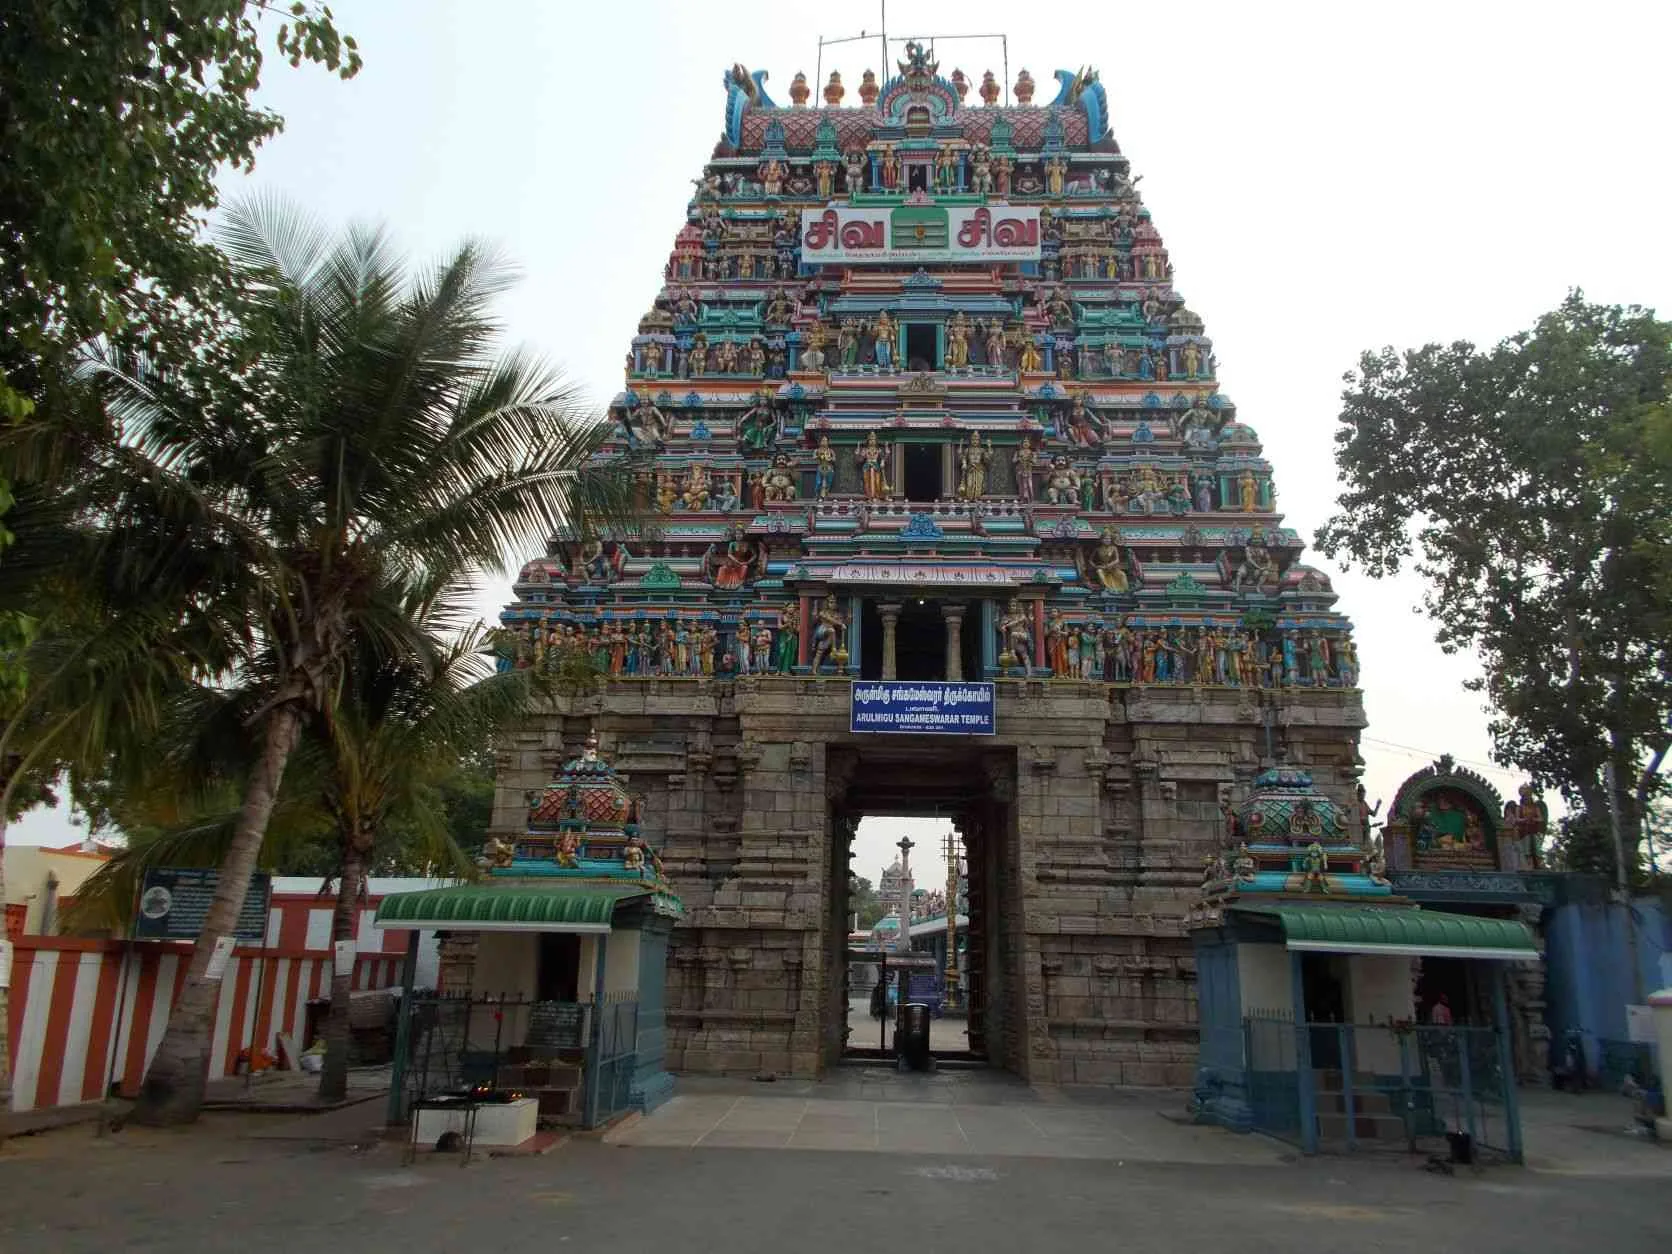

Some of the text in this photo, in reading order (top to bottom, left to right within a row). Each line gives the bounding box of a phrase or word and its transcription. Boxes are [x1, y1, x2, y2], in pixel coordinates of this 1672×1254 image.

[804, 208, 885, 250] சிவ
[957, 207, 1039, 249] சிவ
[854, 685, 890, 704] அருள்மிகு
[943, 687, 991, 706] திருக்கோயில்
[856, 713, 990, 725] ARULMIGU SANGAMESWARAR TEMPLE
